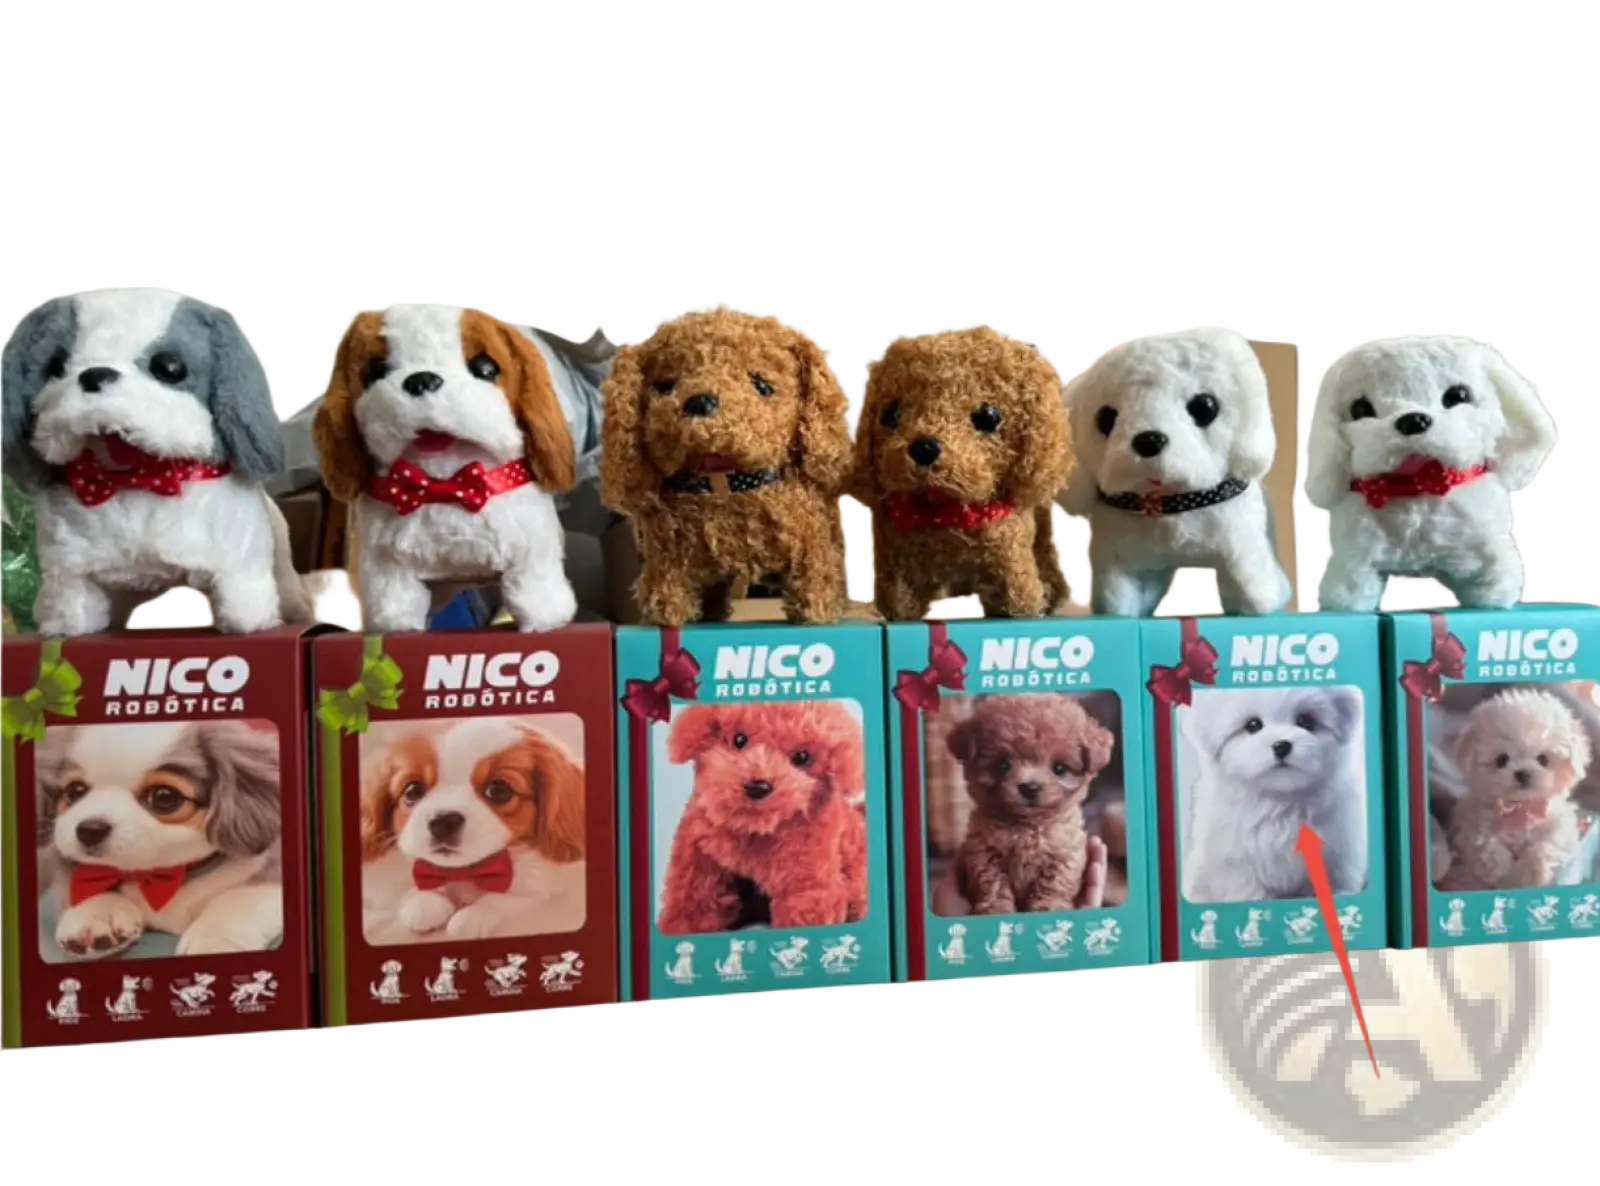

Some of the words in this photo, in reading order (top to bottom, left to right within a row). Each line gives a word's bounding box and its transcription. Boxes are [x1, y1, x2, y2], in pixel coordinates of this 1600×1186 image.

[714, 643, 836, 681] NICO
[980, 634, 1095, 671] NICO
[1230, 632, 1340, 667] NICO
[1477, 627, 1580, 661] NICO
[104, 656, 250, 696] NICO
[423, 650, 560, 689] NICO
